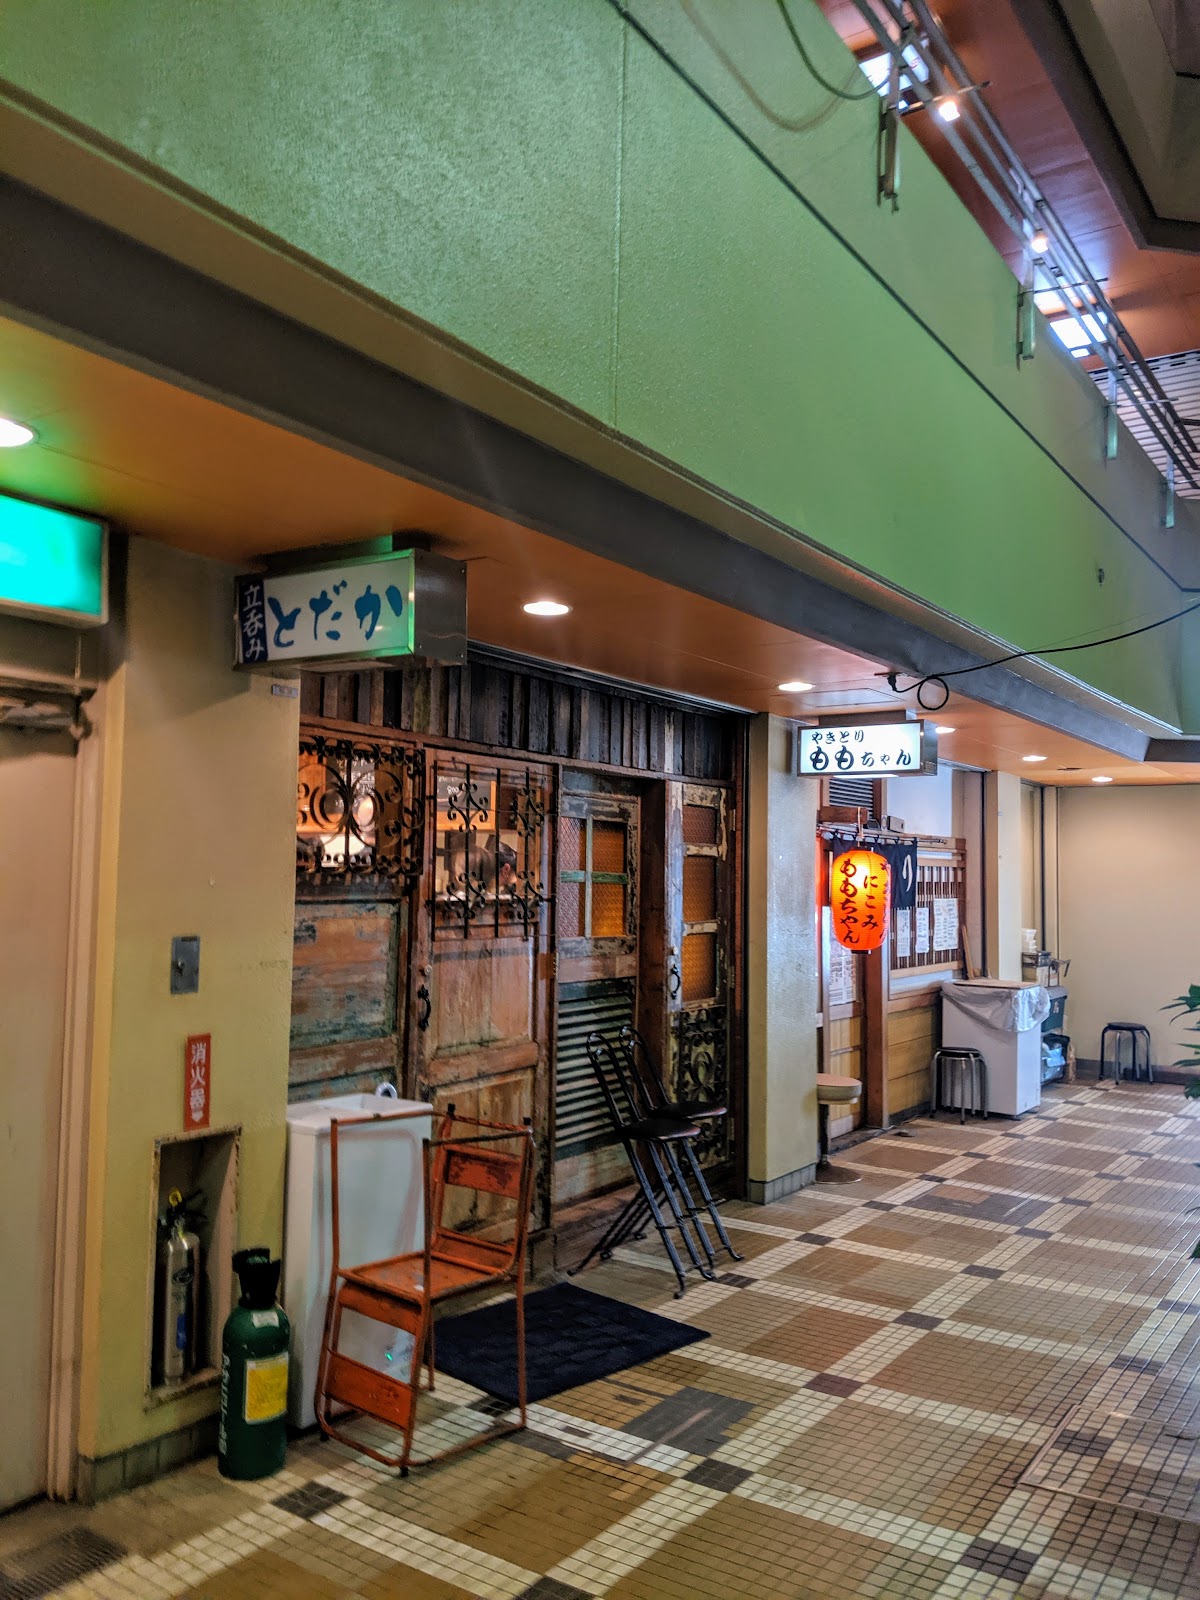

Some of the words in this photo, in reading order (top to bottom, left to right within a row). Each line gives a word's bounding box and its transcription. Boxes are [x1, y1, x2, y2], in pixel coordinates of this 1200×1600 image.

[243, 584, 265, 662] 立呑み
[267, 579, 403, 648] とだか
[809, 744, 912, 772] ももちゃん
[811, 729, 865, 745] やきとり
[861, 874, 879, 931] にこみ
[189, 1042, 207, 1111] 消火器
